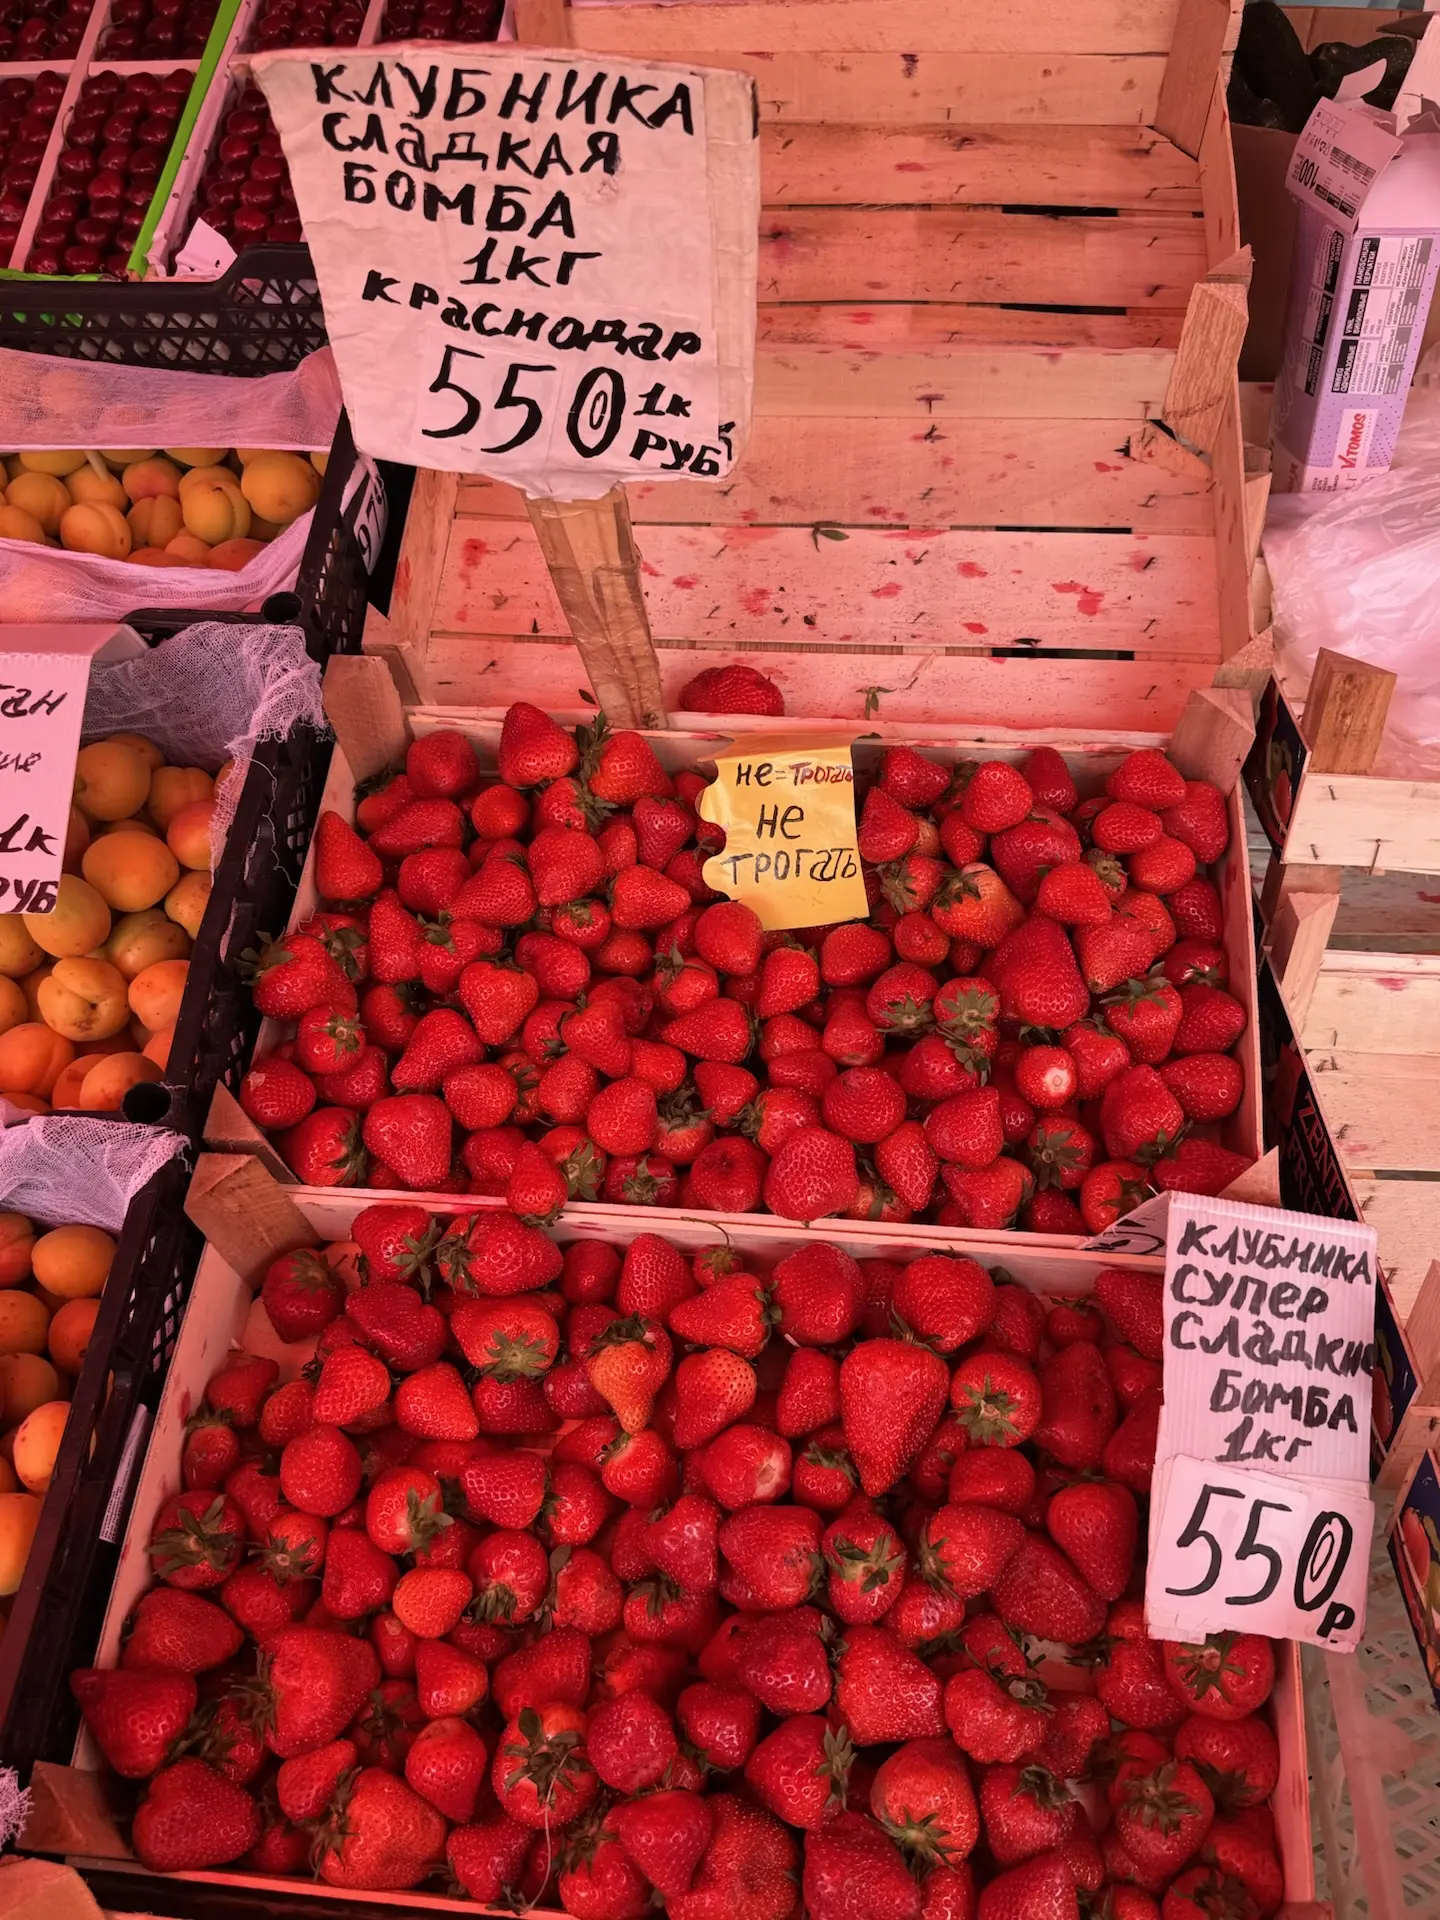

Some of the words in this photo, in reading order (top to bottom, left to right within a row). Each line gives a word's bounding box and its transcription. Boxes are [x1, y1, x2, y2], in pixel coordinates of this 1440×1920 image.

[311, 62, 694, 135] КЛУБНИКА
[344, 162, 575, 239] БОМБА
[1355, 240, 1372, 284] HANDSCHUHE
[1363, 251, 1376, 285] ПЕРЧАТКИ
[1353, 293, 1367, 335] ВИНИЛОВЫЕ
[1333, 368, 1344, 392] EINWEG
[1341, 345, 1356, 392] ОДНОРАЗОВЫЕ
[422, 345, 625, 458] 550
[1178, 1219, 1371, 1285] КЛУБНИКА
[1210, 1369, 1358, 1433] БОМБА
[1165, 1484, 1353, 1611] 550
